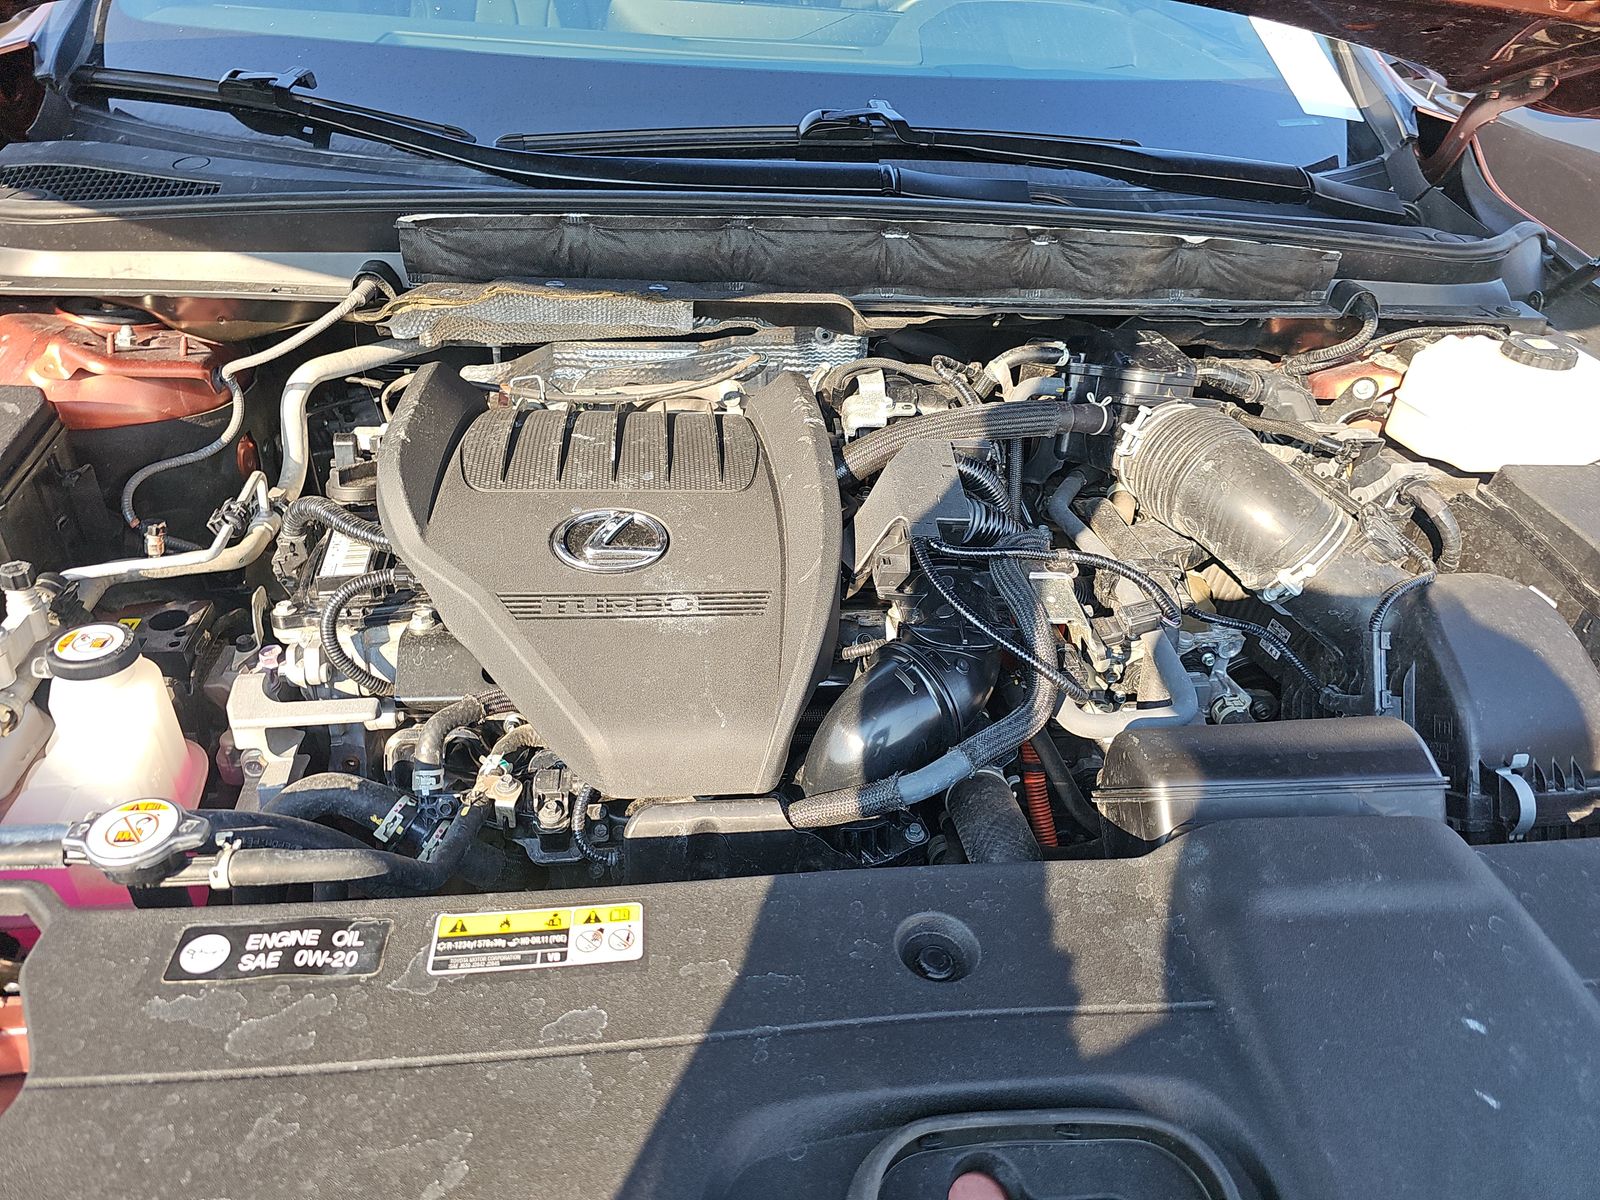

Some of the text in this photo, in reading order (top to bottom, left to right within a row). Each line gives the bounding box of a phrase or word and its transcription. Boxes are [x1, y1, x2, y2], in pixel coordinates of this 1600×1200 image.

[546, 596, 694, 614] TURBO
[245, 929, 365, 951] ENGINE OIL
[237, 950, 359, 972] SAE 0W-20
[487, 954, 521, 962] CORPORATION
